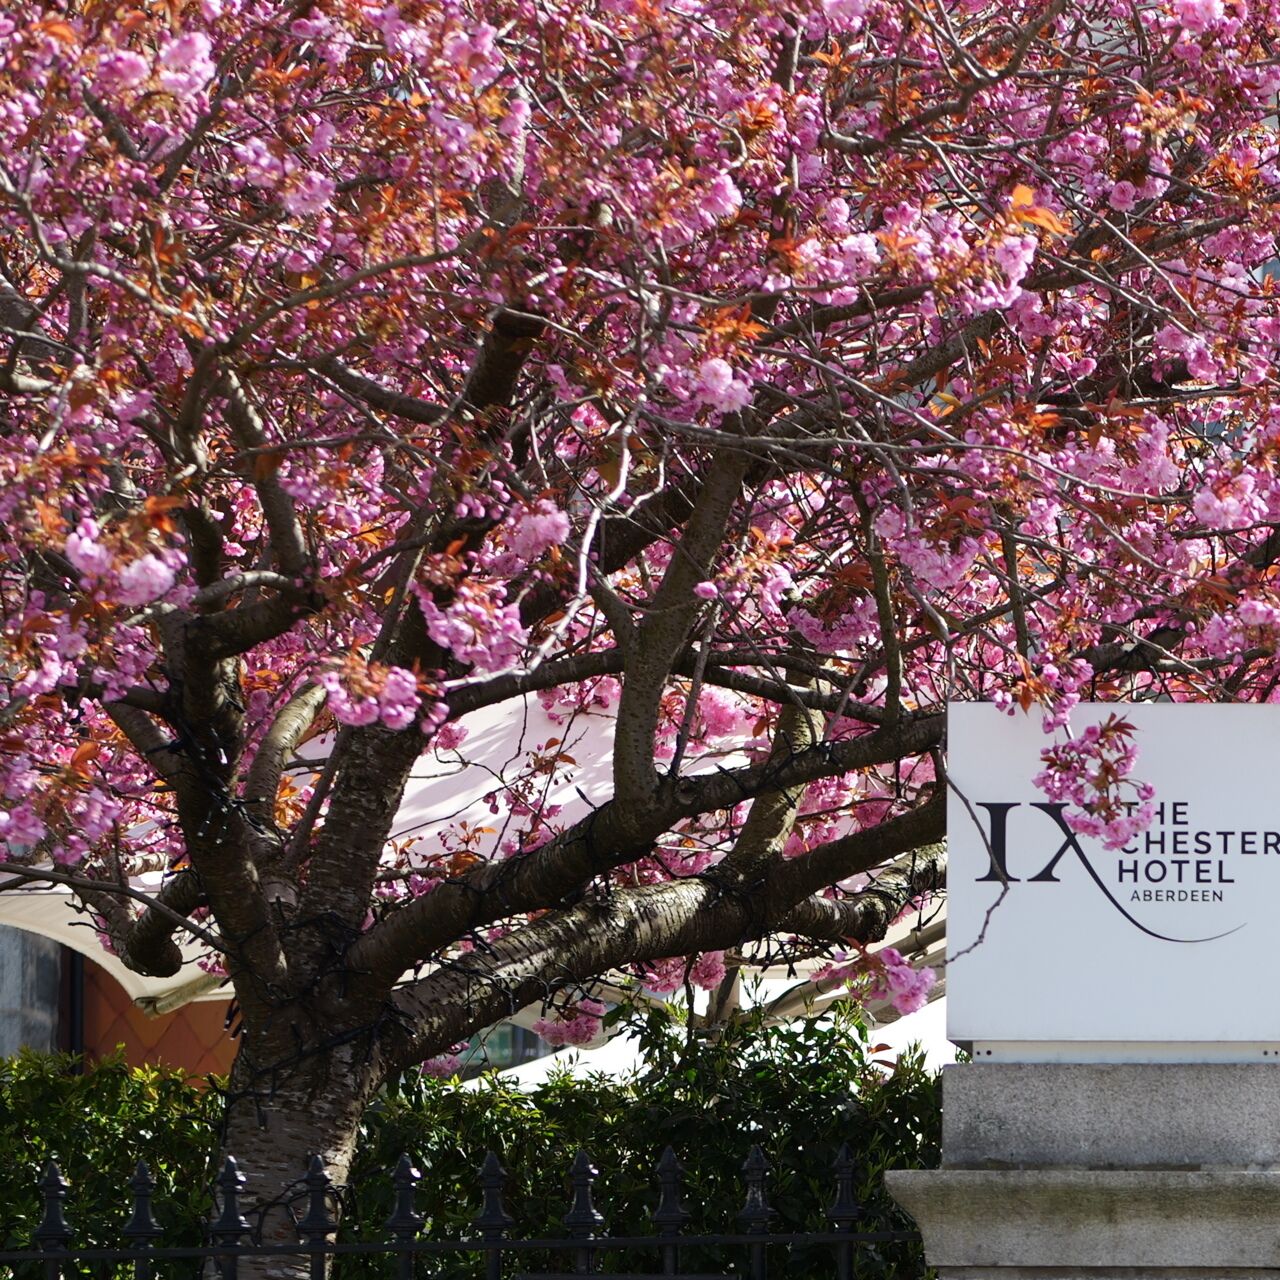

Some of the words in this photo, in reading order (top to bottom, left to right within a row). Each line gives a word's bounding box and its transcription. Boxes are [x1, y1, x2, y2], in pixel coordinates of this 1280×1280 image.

[1120, 802, 1189, 826] THE
[1117, 859, 1236, 884] HOTEL
[1130, 889, 1224, 902] ABERDEEN
